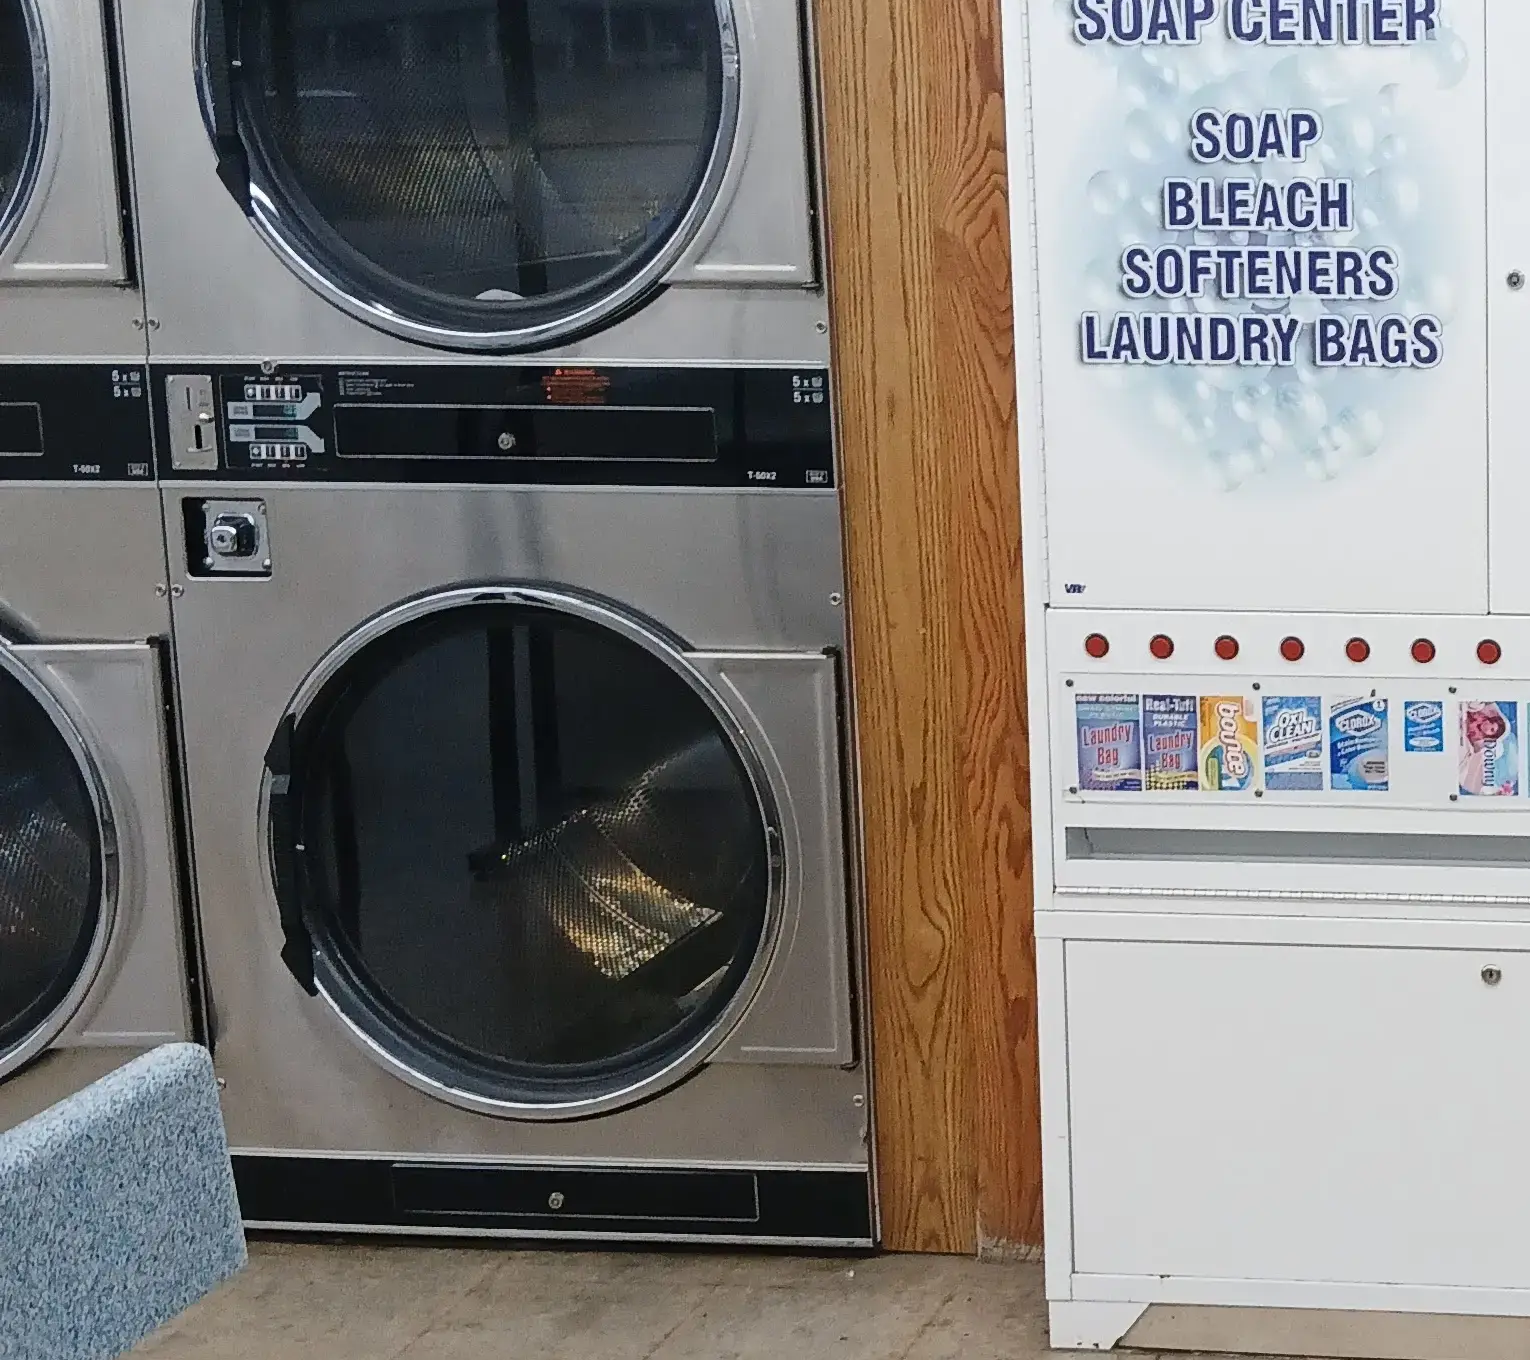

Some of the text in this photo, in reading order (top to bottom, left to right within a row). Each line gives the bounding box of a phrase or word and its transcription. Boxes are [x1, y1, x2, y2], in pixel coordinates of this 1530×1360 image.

[1193, 112, 1319, 160] SOAP
[1167, 180, 1350, 228] BLEACH
[1123, 248, 1396, 296] SOFTENERS
[1083, 314, 1441, 364] LAUNDRY BAGS
[792, 375, 801, 388] 5
[793, 391, 802, 403] 5
[1278, 710, 1305, 728] OXI
[1339, 714, 1376, 732] CLOROX
[1082, 723, 1132, 747] Laundry
[1149, 730, 1193, 752] Laundry
[1216, 702, 1246, 776] bounce
[1269, 720, 1314, 744] CLEAN
[1097, 746, 1120, 767] Bag
[1161, 752, 1181, 770] Bag
